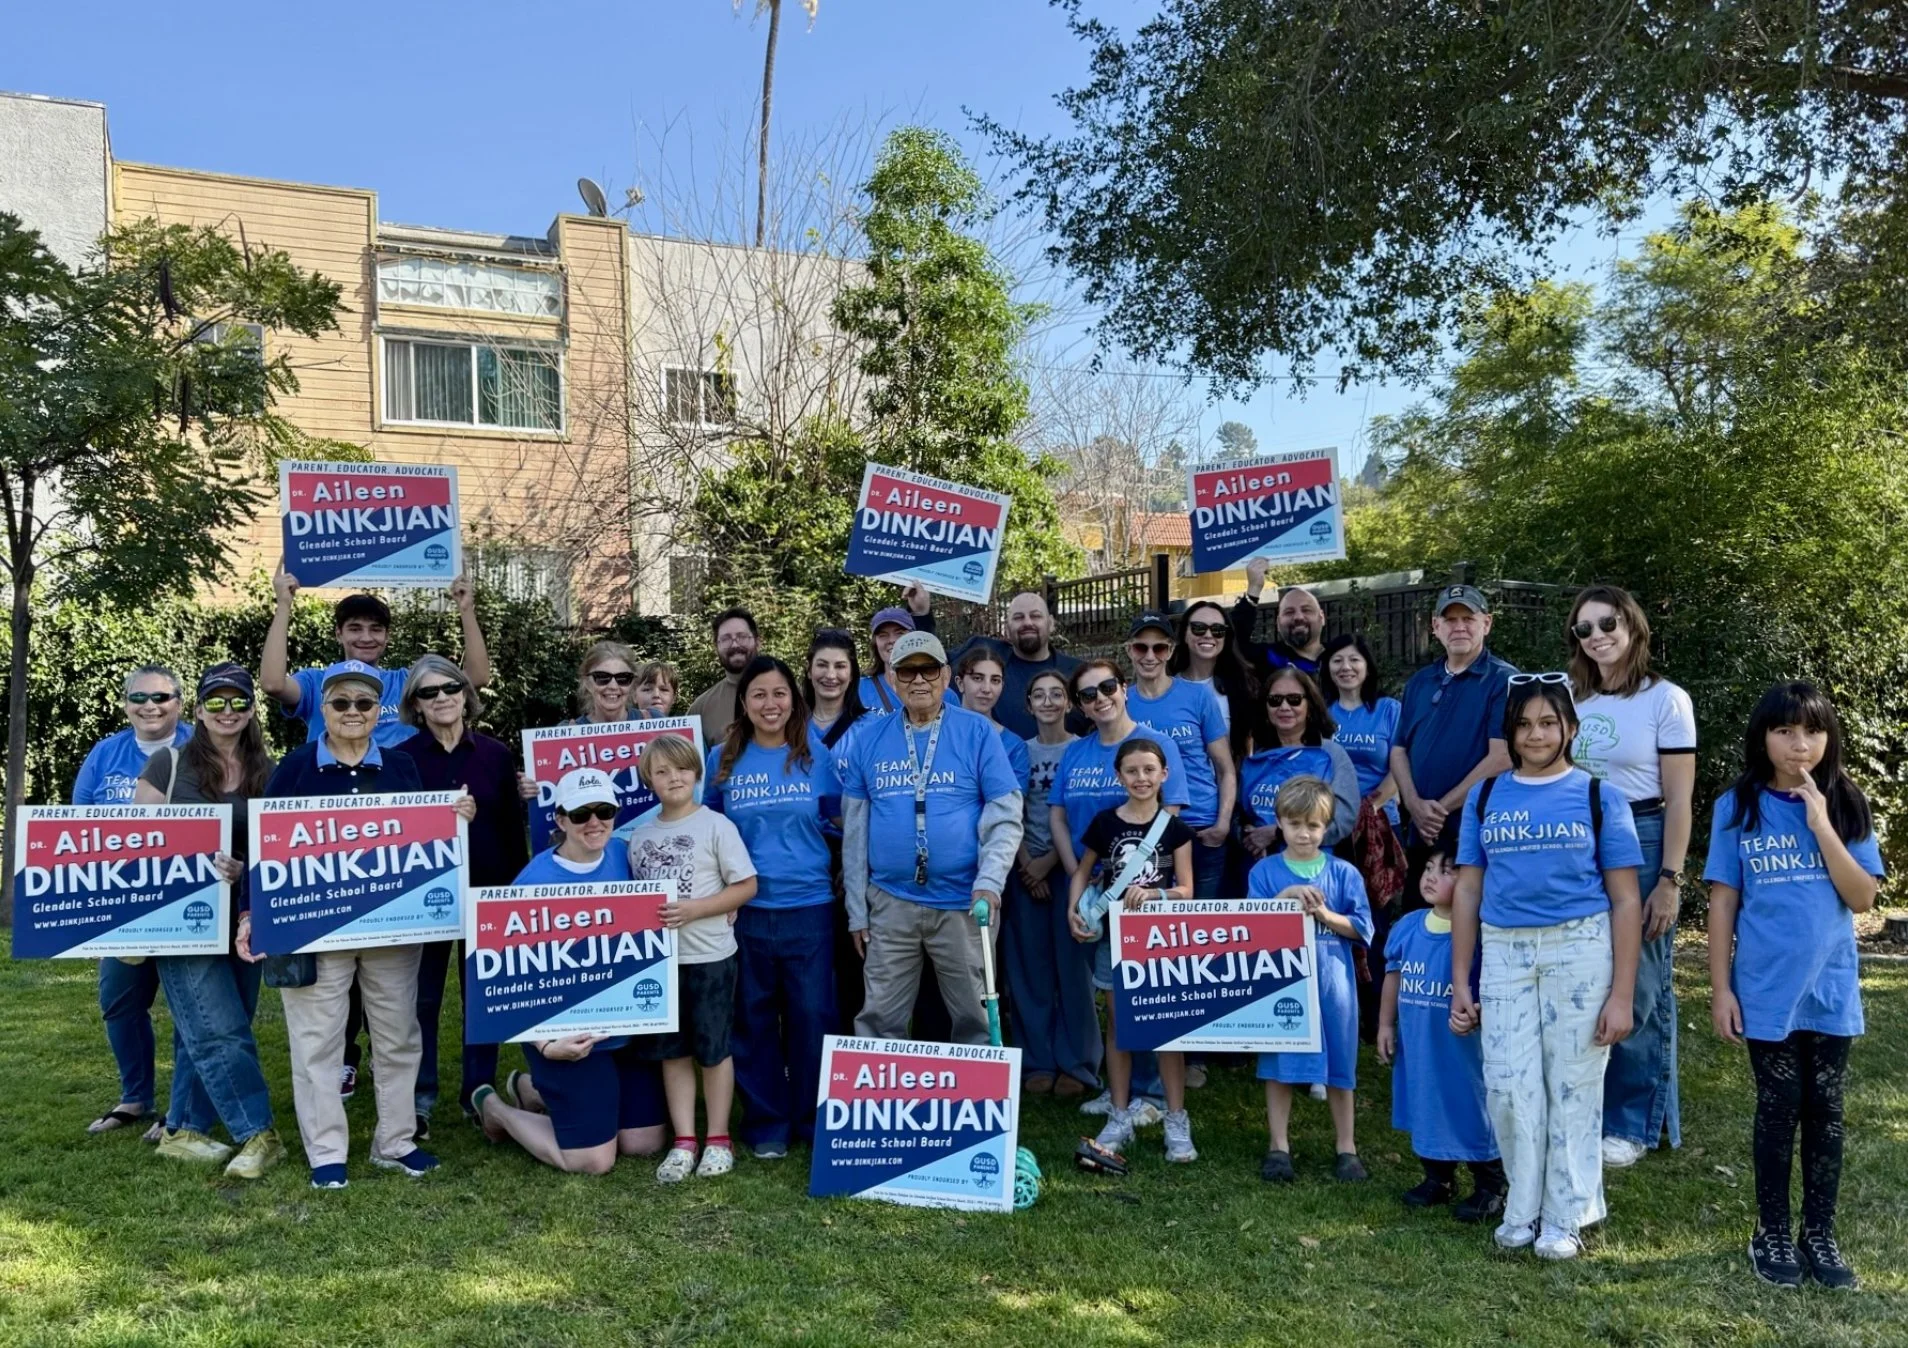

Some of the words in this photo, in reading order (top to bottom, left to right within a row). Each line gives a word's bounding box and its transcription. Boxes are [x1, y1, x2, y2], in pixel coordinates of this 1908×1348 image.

[291, 463, 332, 472] PARENT.
[337, 464, 390, 474] EDUCATOR.
[395, 466, 447, 476] ADVOCATE.
[1196, 463, 1229, 472] PARENT.
[313, 480, 405, 502] Aileen
[1214, 472, 1292, 498] Aileen
[886, 488, 962, 515] Aileen
[1196, 482, 1337, 529] DINKJIAN
[290, 504, 455, 536] DINKJIAN
[862, 507, 999, 550] DINKJIAN
[1204, 528, 1237, 540] Glendale
[1241, 523, 1267, 533] School
[1271, 516, 1294, 527] Board
[299, 540, 340, 550] Glendale
[344, 538, 375, 547] School
[380, 535, 407, 544] Board
[864, 535, 897, 547] Glendale
[535, 729, 576, 739] PARENT.
[581, 724, 634, 736] EDUCATOR.
[639, 719, 690, 731] ADVOCATE.
[1332, 733, 1374, 744] KJIAN
[1582, 724, 1608, 735] USD
[875, 760, 912, 773] TEAM
[1072, 767, 1104, 776] TEAM
[729, 773, 768, 786] TEAM
[876, 771, 955, 790] DINKAN
[1069, 776, 1122, 789] DINKJIA
[626, 795, 653, 805] Board
[731, 782, 811, 801] DINKJIAN
[31, 808, 79, 818] PARENT.
[86, 808, 149, 818] EDUCATOR.
[156, 807, 219, 817] ADVOCATE.
[263, 800, 313, 811] PARENT.
[320, 797, 385, 809] EDUCATOR.
[391, 794, 454, 805] ADVOCATE.
[30, 841, 47, 849] DR.
[54, 828, 166, 855] Aileen
[264, 834, 281, 843] DR.
[289, 818, 402, 848] Aileen
[1483, 822, 1586, 843] DINKJIAN
[1740, 834, 1798, 854] TEAM
[260, 836, 463, 892] DINKJIAN
[1750, 853, 1825, 874] DINKJI
[25, 852, 223, 897] DINKJIAN
[270, 892, 321, 908] Glendale
[326, 884, 365, 900] School
[370, 879, 403, 893] Board
[480, 889, 528, 899] PARENT.
[534, 886, 596, 897] EDUCATOR.
[603, 883, 664, 894] ADVOCATE.
[33, 896, 82, 913] Glendale
[88, 892, 125, 907] School
[131, 891, 164, 904] Board
[1172, 903, 1232, 912] EDUCATOR.
[1239, 902, 1300, 911] ADVOCATE.
[480, 923, 496, 931] DR.
[504, 907, 613, 937] Aileen
[1146, 922, 1250, 949] Aileen
[476, 927, 672, 980] DINKJIAN
[1121, 946, 1311, 990] DINKJIAN
[485, 981, 533, 997] Glendale
[539, 975, 576, 989] School
[581, 969, 613, 983] Board
[1401, 978, 1453, 997] INKJIA
[1132, 994, 1176, 1006] Glendale
[1181, 990, 1217, 1001] School
[1221, 986, 1252, 997] Board
[836, 1039, 878, 1051] PARENT.
[884, 1043, 943, 1056] EDUCATOR.
[949, 1046, 1008, 1061] ADVOCATE.
[833, 1073, 848, 1081] DR.
[854, 1063, 957, 1089] Aileen
[826, 1098, 1012, 1131] DINKJIAN
[831, 1137, 876, 1149] Glendale
[881, 1137, 916, 1148] School
[921, 1137, 952, 1147] Board
[974, 1157, 996, 1165] GUSD
